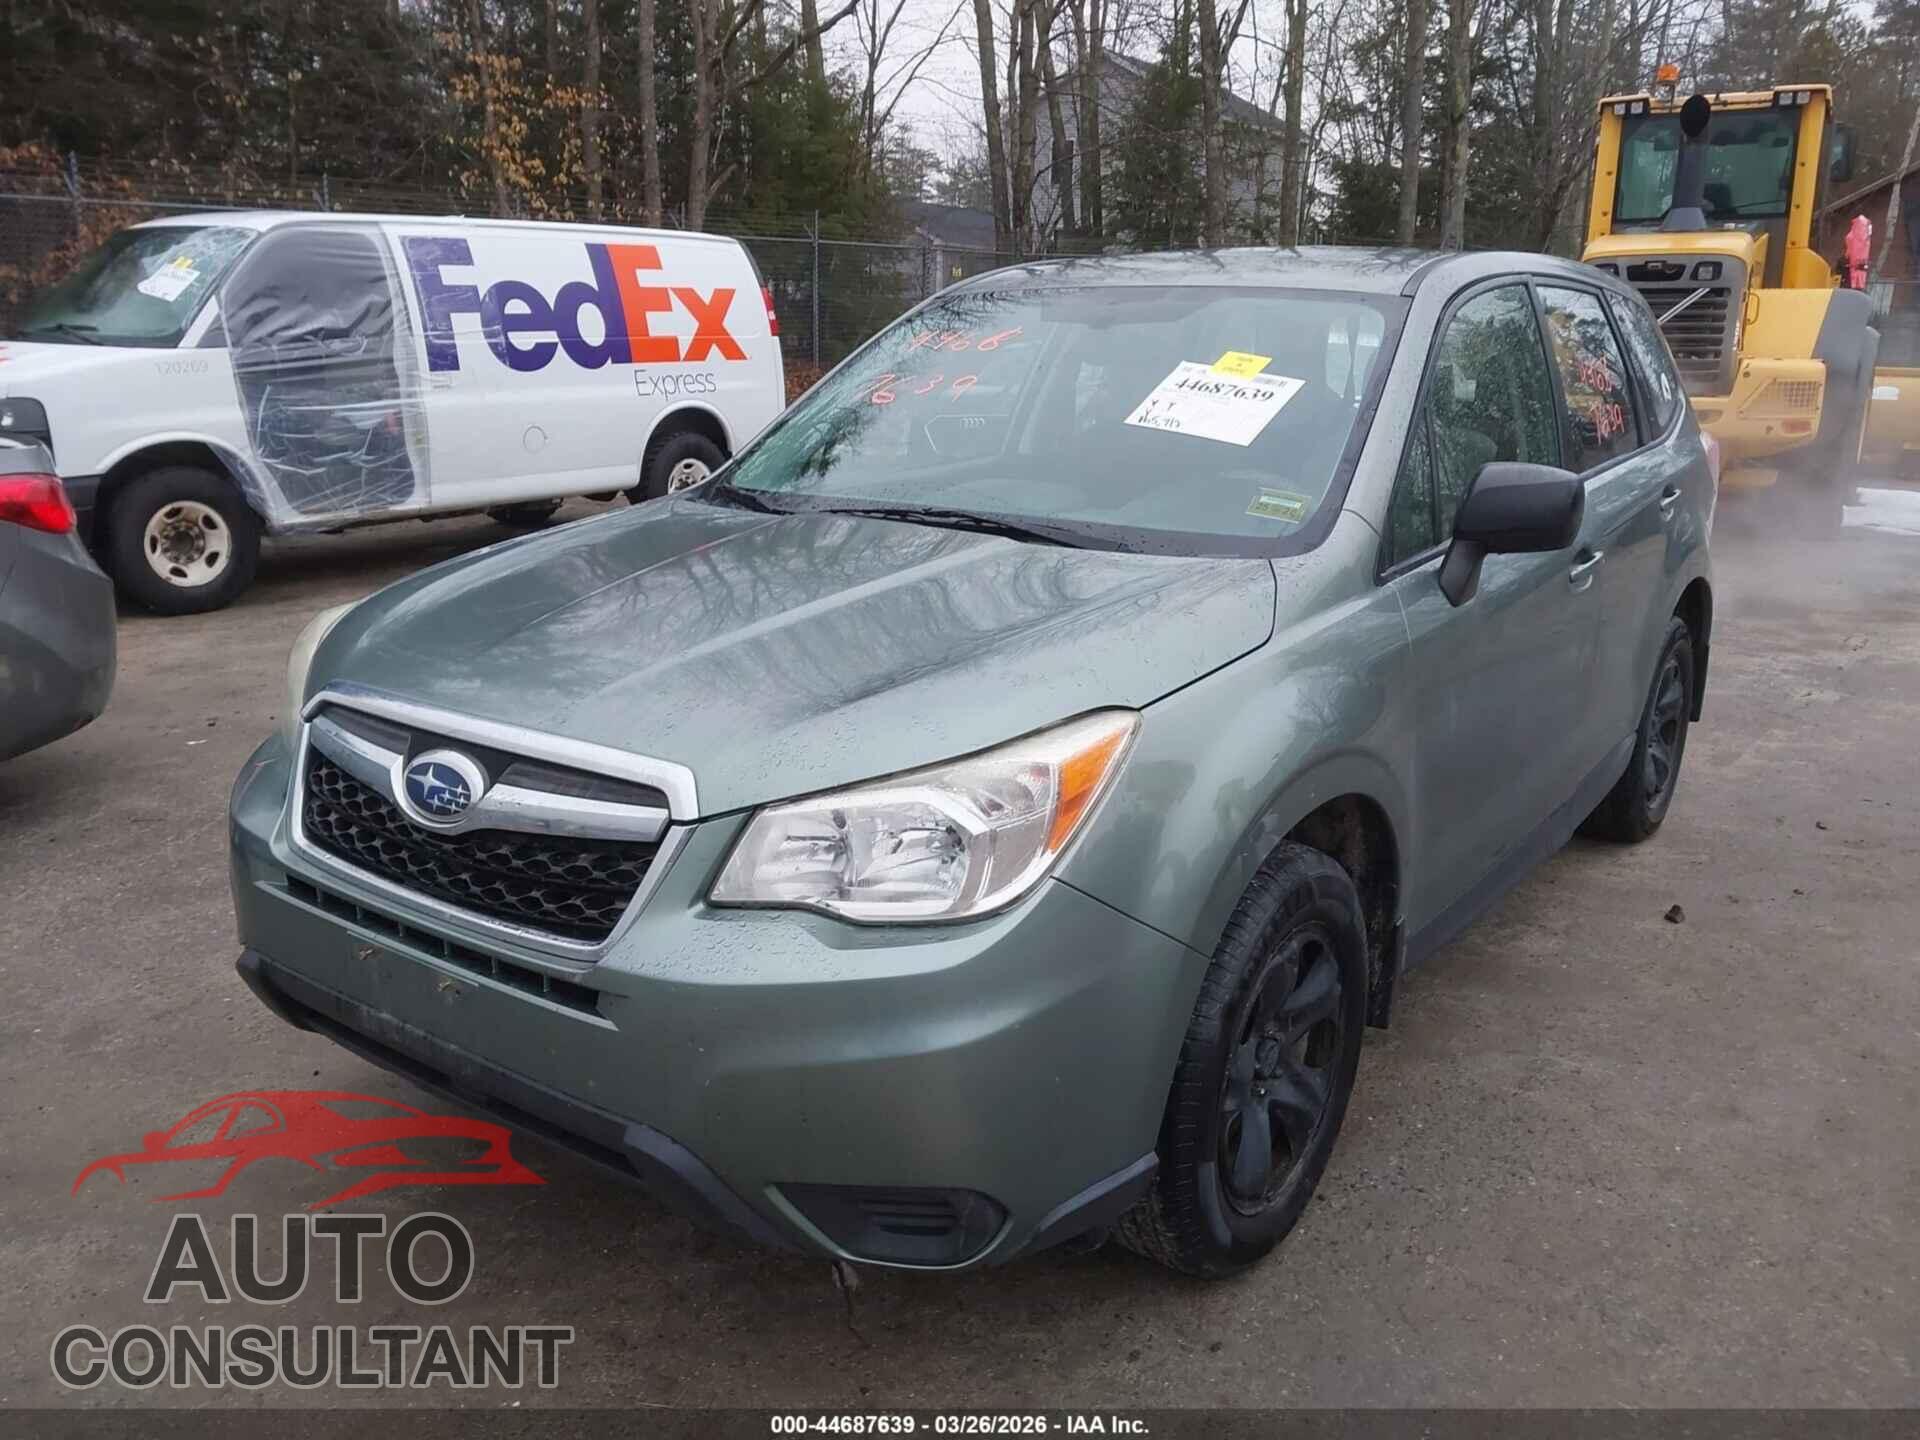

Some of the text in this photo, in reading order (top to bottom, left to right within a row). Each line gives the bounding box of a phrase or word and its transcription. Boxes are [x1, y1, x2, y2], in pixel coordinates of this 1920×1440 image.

[406, 235, 747, 373] FedEx
[634, 369, 717, 401] Express
[1175, 377, 1275, 402] 44687639
